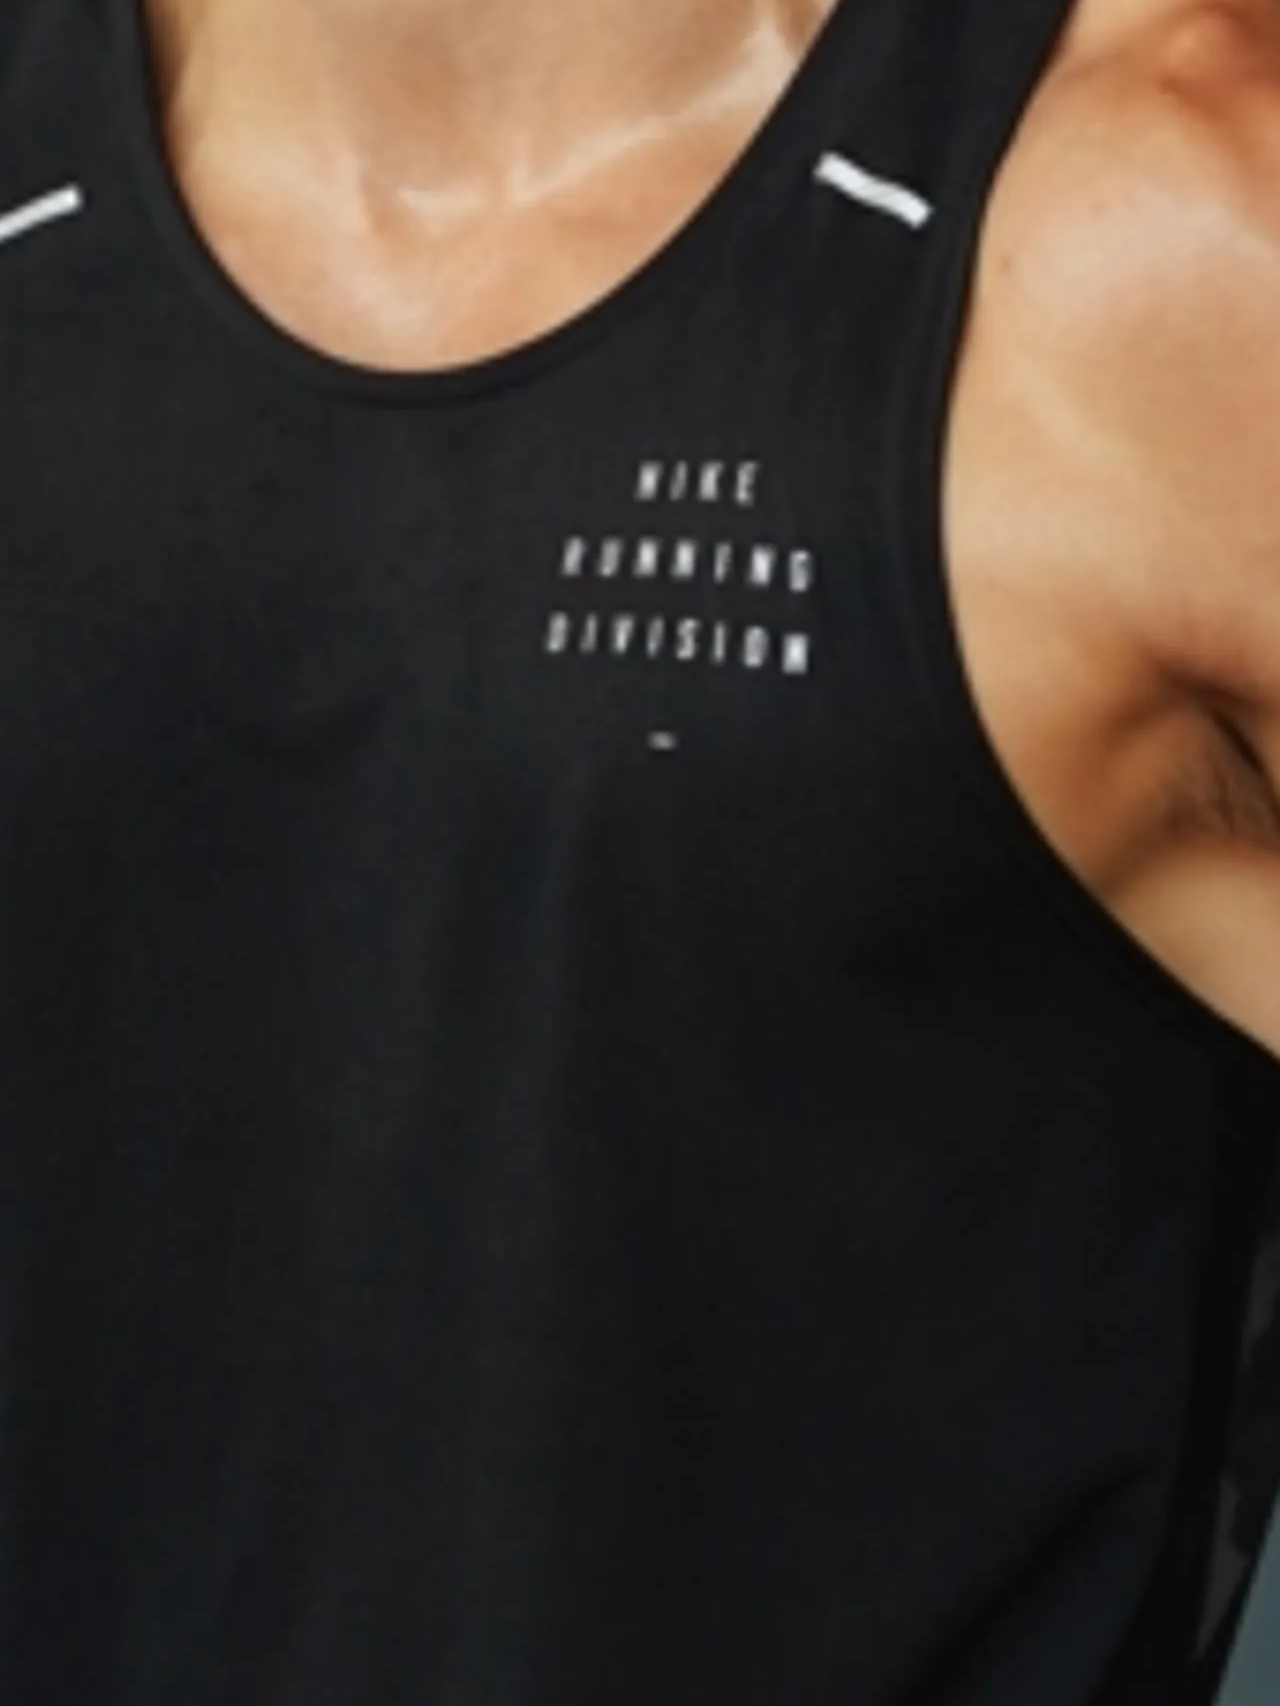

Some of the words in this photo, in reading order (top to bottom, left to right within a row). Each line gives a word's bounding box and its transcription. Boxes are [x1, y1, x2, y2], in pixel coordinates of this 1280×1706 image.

[635, 459, 758, 506] NIKE
[561, 536, 812, 593] RUNNING
[545, 611, 809, 675] DIVISION
